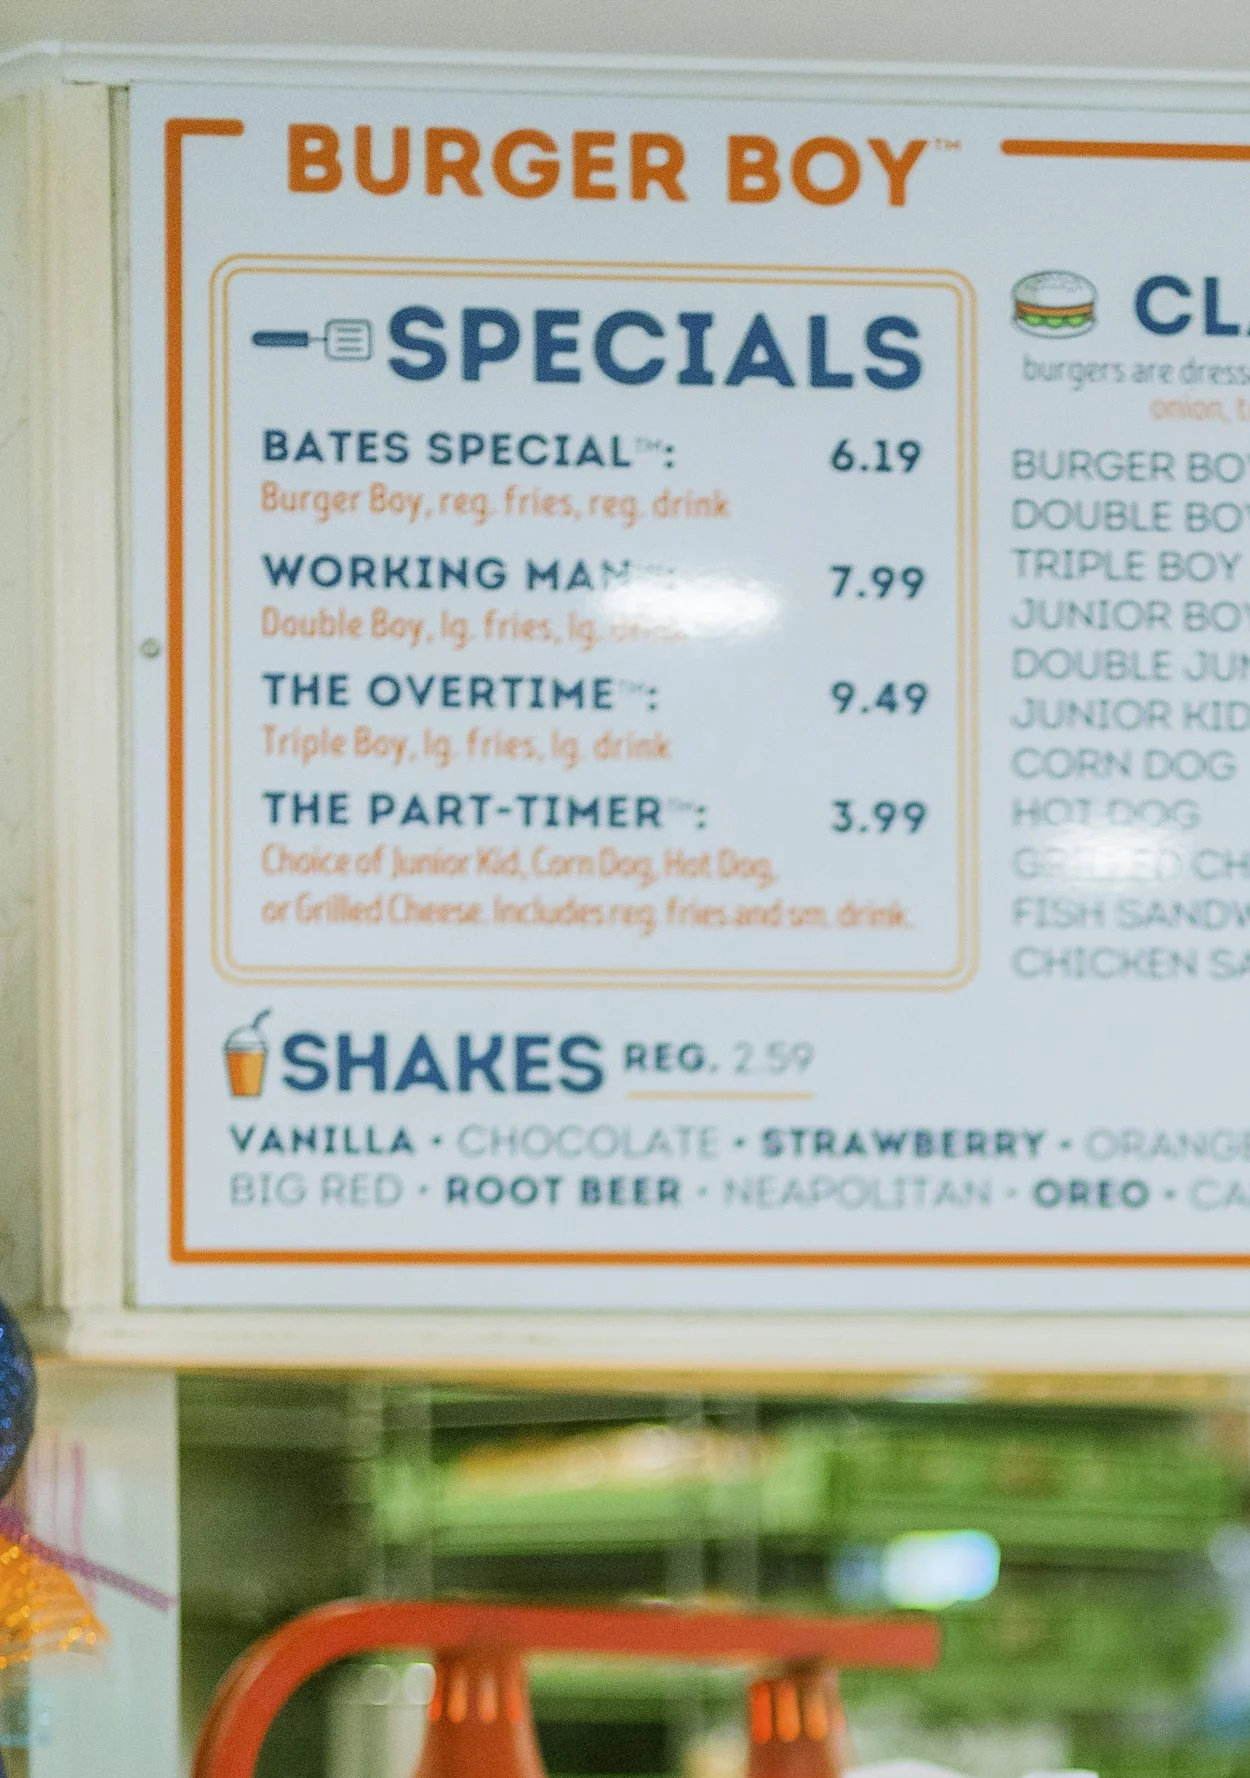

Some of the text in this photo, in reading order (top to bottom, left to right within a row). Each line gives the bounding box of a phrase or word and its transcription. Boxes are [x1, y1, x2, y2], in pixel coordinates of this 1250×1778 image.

[288, 123, 688, 202] BURGER
[388, 305, 923, 391] SPECIALS
[1022, 352, 1126, 392] burgers
[1131, 362, 1173, 384] are
[1149, 399, 1229, 422] onion,
[263, 428, 410, 464] BATES
[830, 438, 922, 474] 6.19
[1011, 448, 1175, 483] BURGER
[260, 480, 731, 530] Burger Boy, reg. fries, reg. drink
[1011, 497, 1172, 533] DOUBLE
[262, 554, 926, 600] WORKING 7.99
[1010, 547, 1144, 582] TRIPLE
[1158, 550, 1243, 583] BOY
[261, 605, 364, 639] Double
[370, 607, 433, 648] Boy,
[483, 608, 562, 645] fries,
[1010, 597, 1171, 632] JUNIOR
[1011, 646, 1171, 682] DOUBLE
[262, 672, 349, 708] THE
[830, 680, 929, 715] 9.49
[1009, 696, 1171, 732] JUNIOR
[263, 723, 347, 766] Triple
[353, 725, 416, 765] Boy,
[466, 726, 544, 762] fries,
[592, 729, 672, 761] drink
[1010, 746, 1132, 781] CORN
[1143, 748, 1238, 782] DOG
[262, 791, 349, 826] THE
[832, 799, 928, 834] 3.99
[1011, 797, 1092, 828] HOT
[1105, 797, 1202, 830] DOG
[261, 843, 779, 891] Choice of Junior Kid, Corn Dog, Hot Dog,
[261, 901, 290, 924] or
[295, 892, 383, 925] Grilled
[493, 894, 602, 928] Includes
[666, 896, 734, 929] fries
[733, 896, 784, 928] and
[788, 904, 832, 928] sm.
[1011, 895, 1105, 930] FISH
[1011, 945, 1198, 981] CHICKEN
[281, 1031, 815, 1095] SHAKES REG. 2.59
[229, 1125, 415, 1156] VANILLA
[457, 1124, 719, 1161] CHOCOLATE
[761, 1127, 1045, 1159] STRAWBERRY
[229, 1172, 307, 1207] BIG
[320, 1172, 404, 1207] RED
[445, 1175, 563, 1206] ROOT
[579, 1175, 681, 1207] BEER
[722, 1174, 993, 1210] NEAPOLITAN
[1031, 1177, 1151, 1210] OREO
